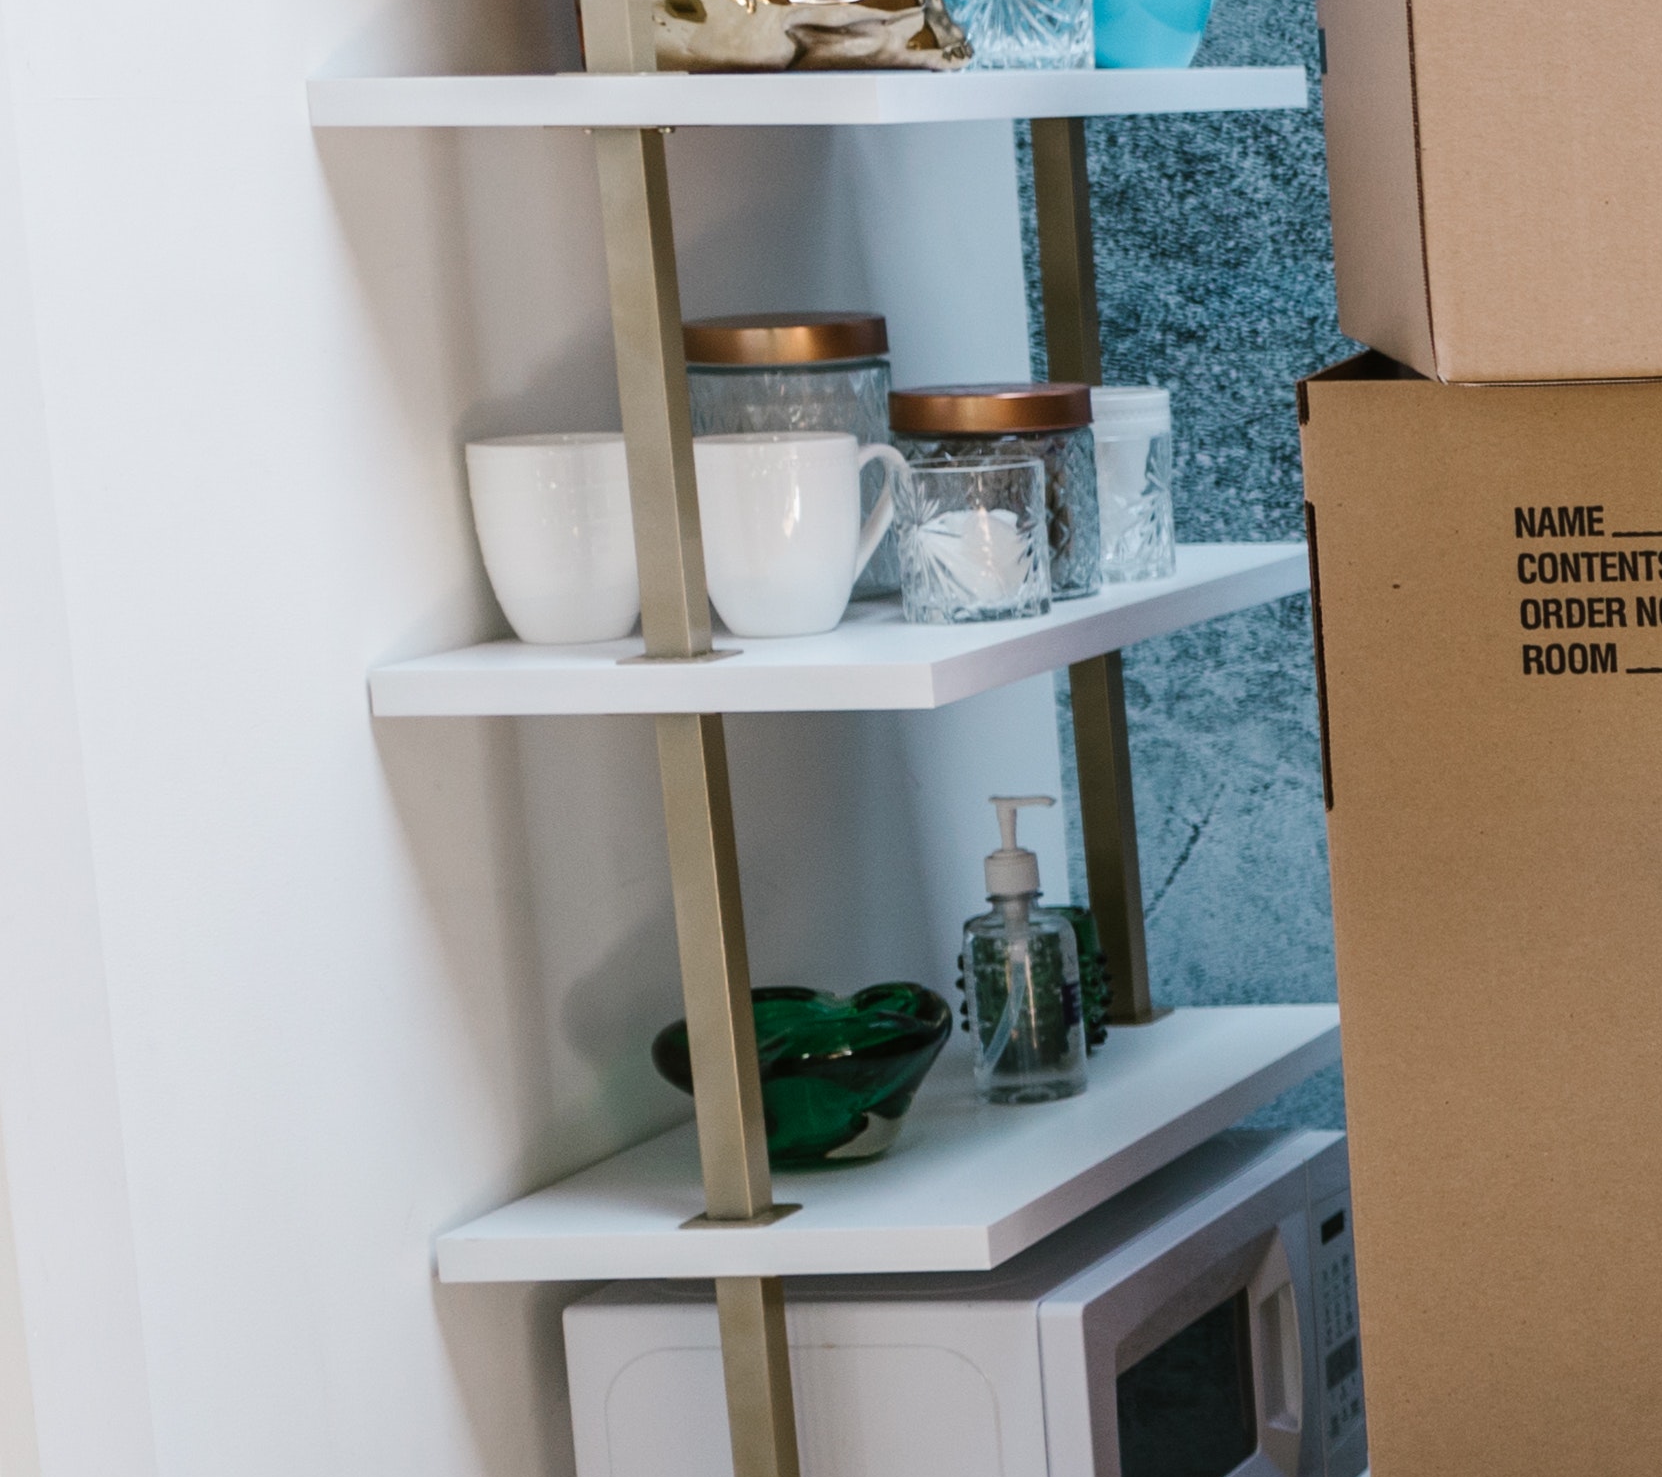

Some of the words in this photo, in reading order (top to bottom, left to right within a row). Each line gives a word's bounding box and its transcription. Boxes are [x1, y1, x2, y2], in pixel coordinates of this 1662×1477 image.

[1514, 505, 1605, 538] NAME
[1520, 596, 1627, 630] ORDER
[1522, 642, 1618, 676] ROOM
